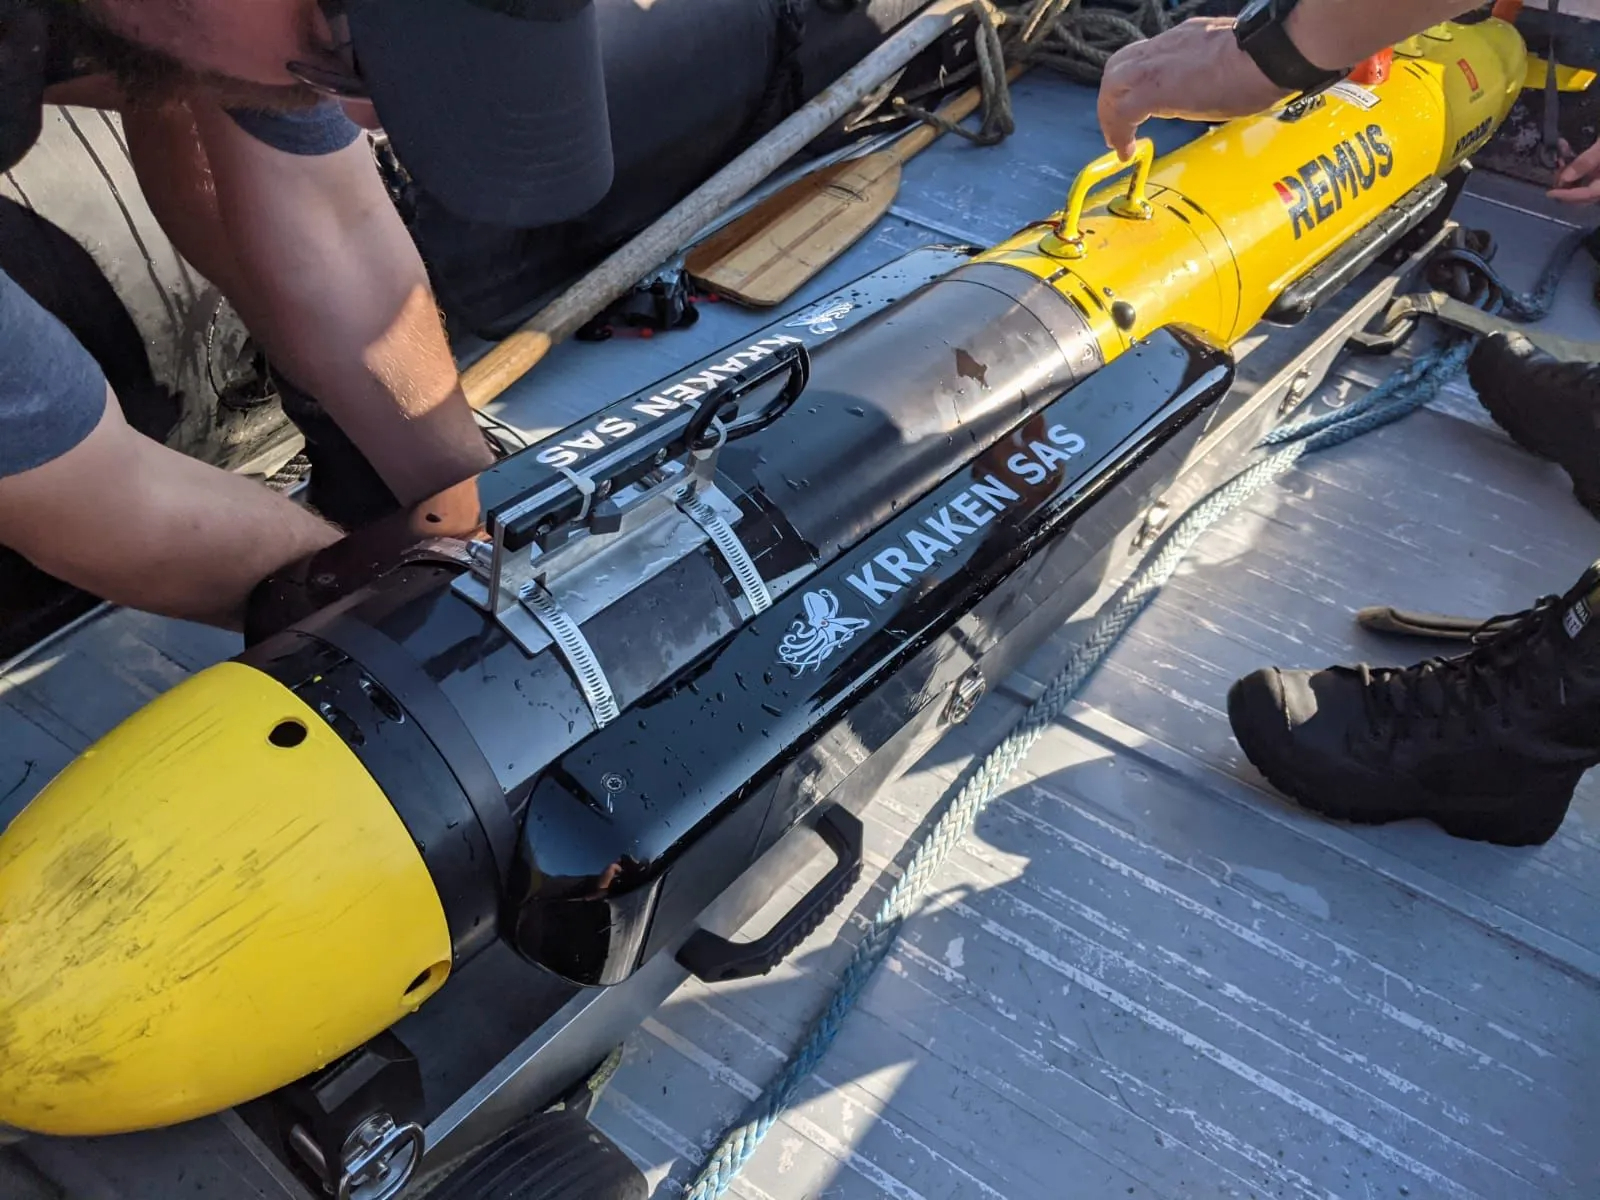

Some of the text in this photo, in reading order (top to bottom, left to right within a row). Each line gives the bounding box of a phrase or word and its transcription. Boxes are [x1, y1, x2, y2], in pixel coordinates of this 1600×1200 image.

[1272, 123, 1394, 241] REMUS
[535, 416, 638, 468] SAS
[845, 423, 1086, 605] KRAKEN SAS
